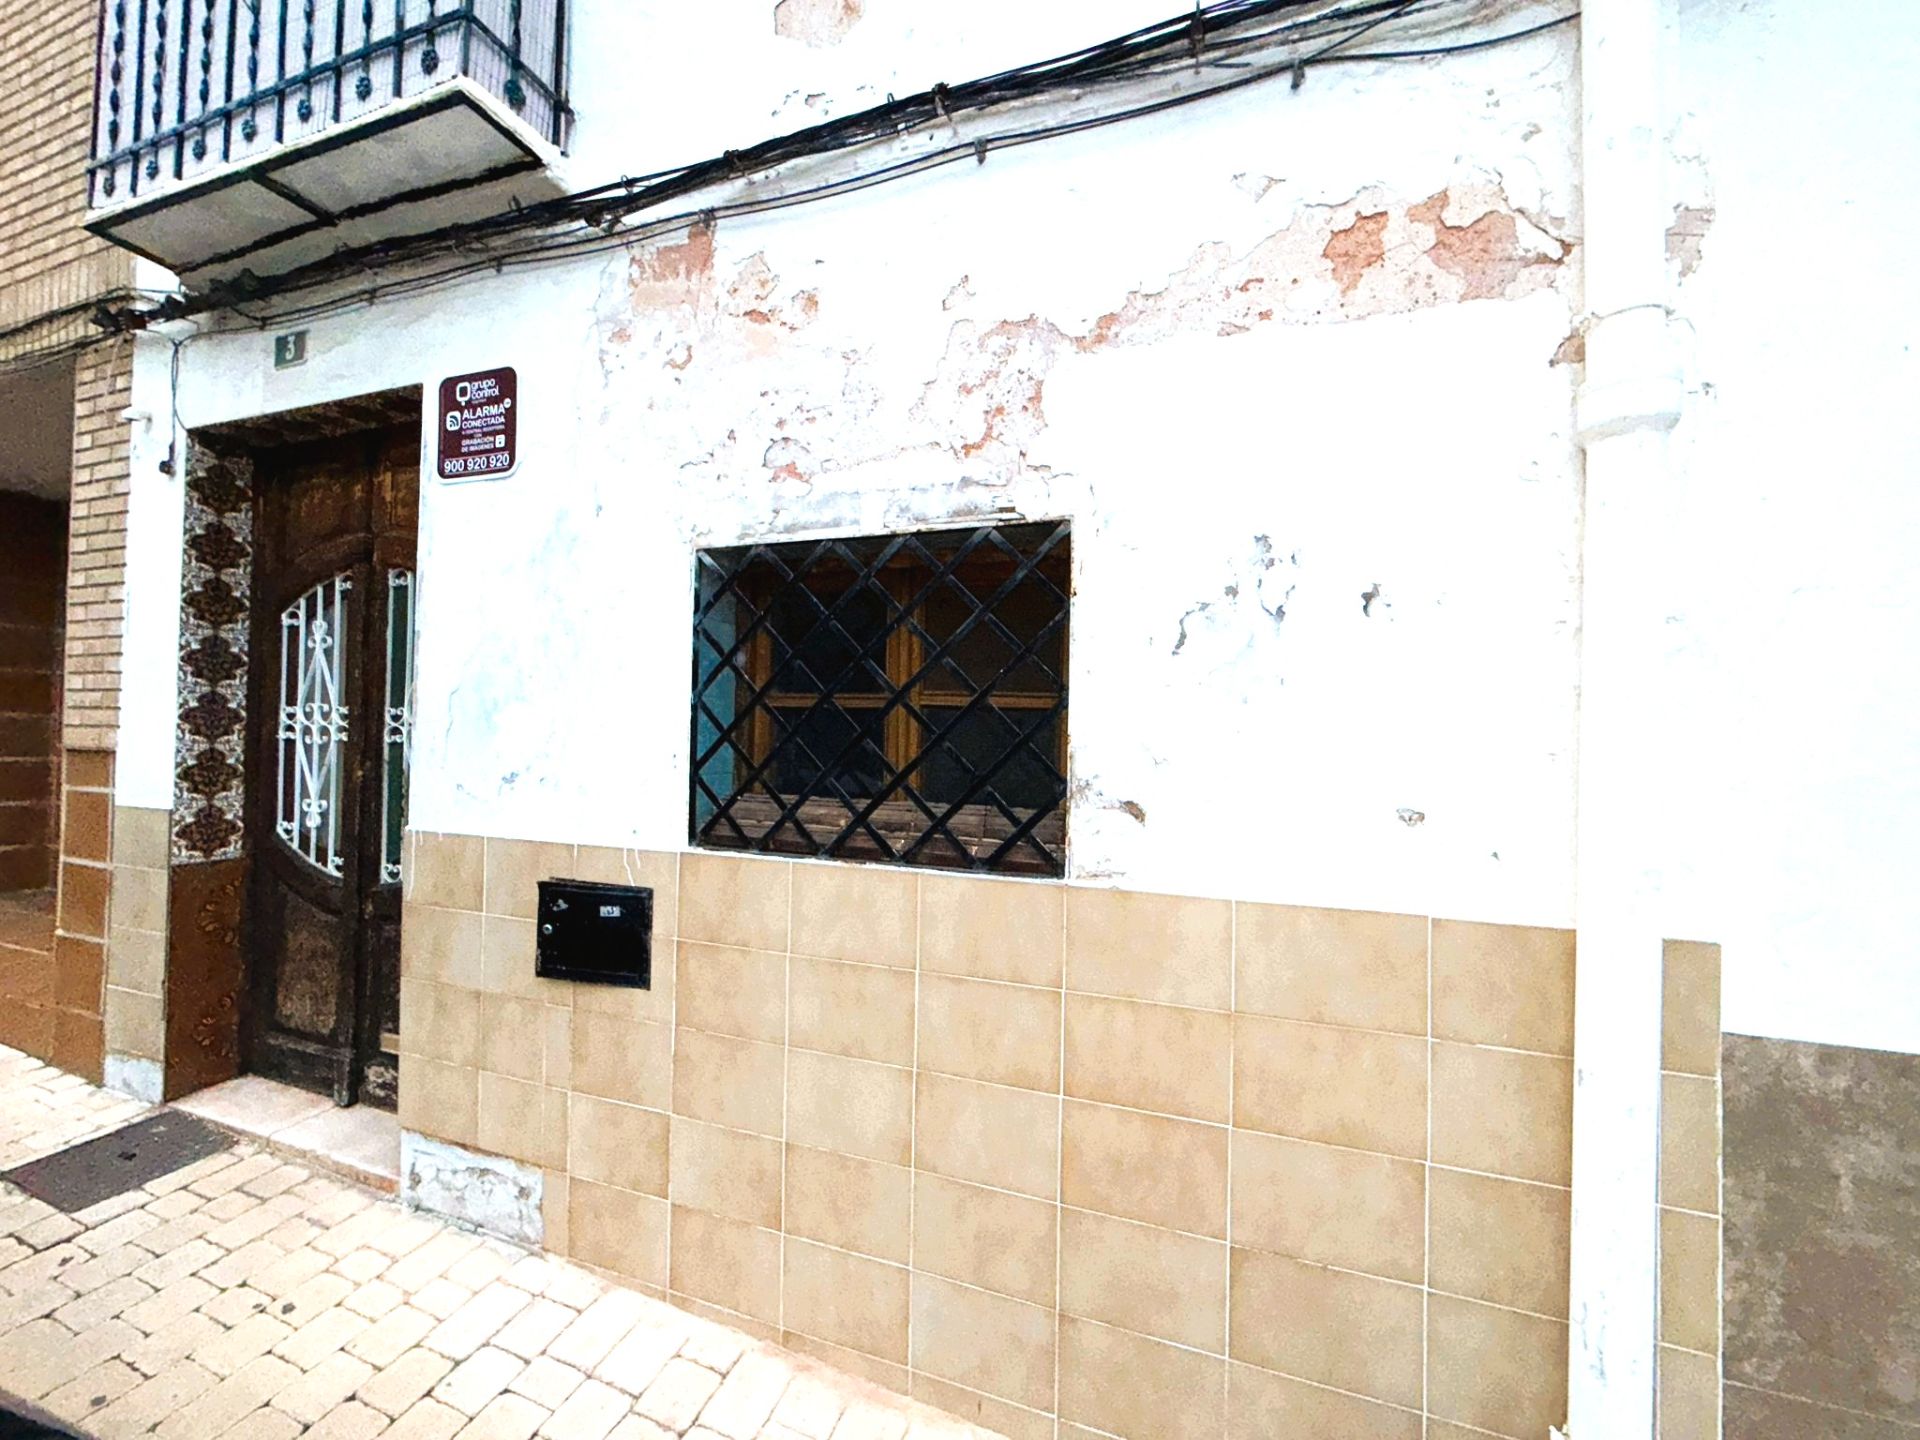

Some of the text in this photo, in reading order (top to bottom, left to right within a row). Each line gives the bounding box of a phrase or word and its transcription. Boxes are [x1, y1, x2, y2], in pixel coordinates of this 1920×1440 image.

[285, 335, 295, 360] 3
[471, 378, 496, 389] grupo
[471, 385, 499, 399] control
[462, 403, 506, 420] ALARMA
[461, 415, 506, 429] CONECTADA
[444, 453, 510, 473] 900 920 920
